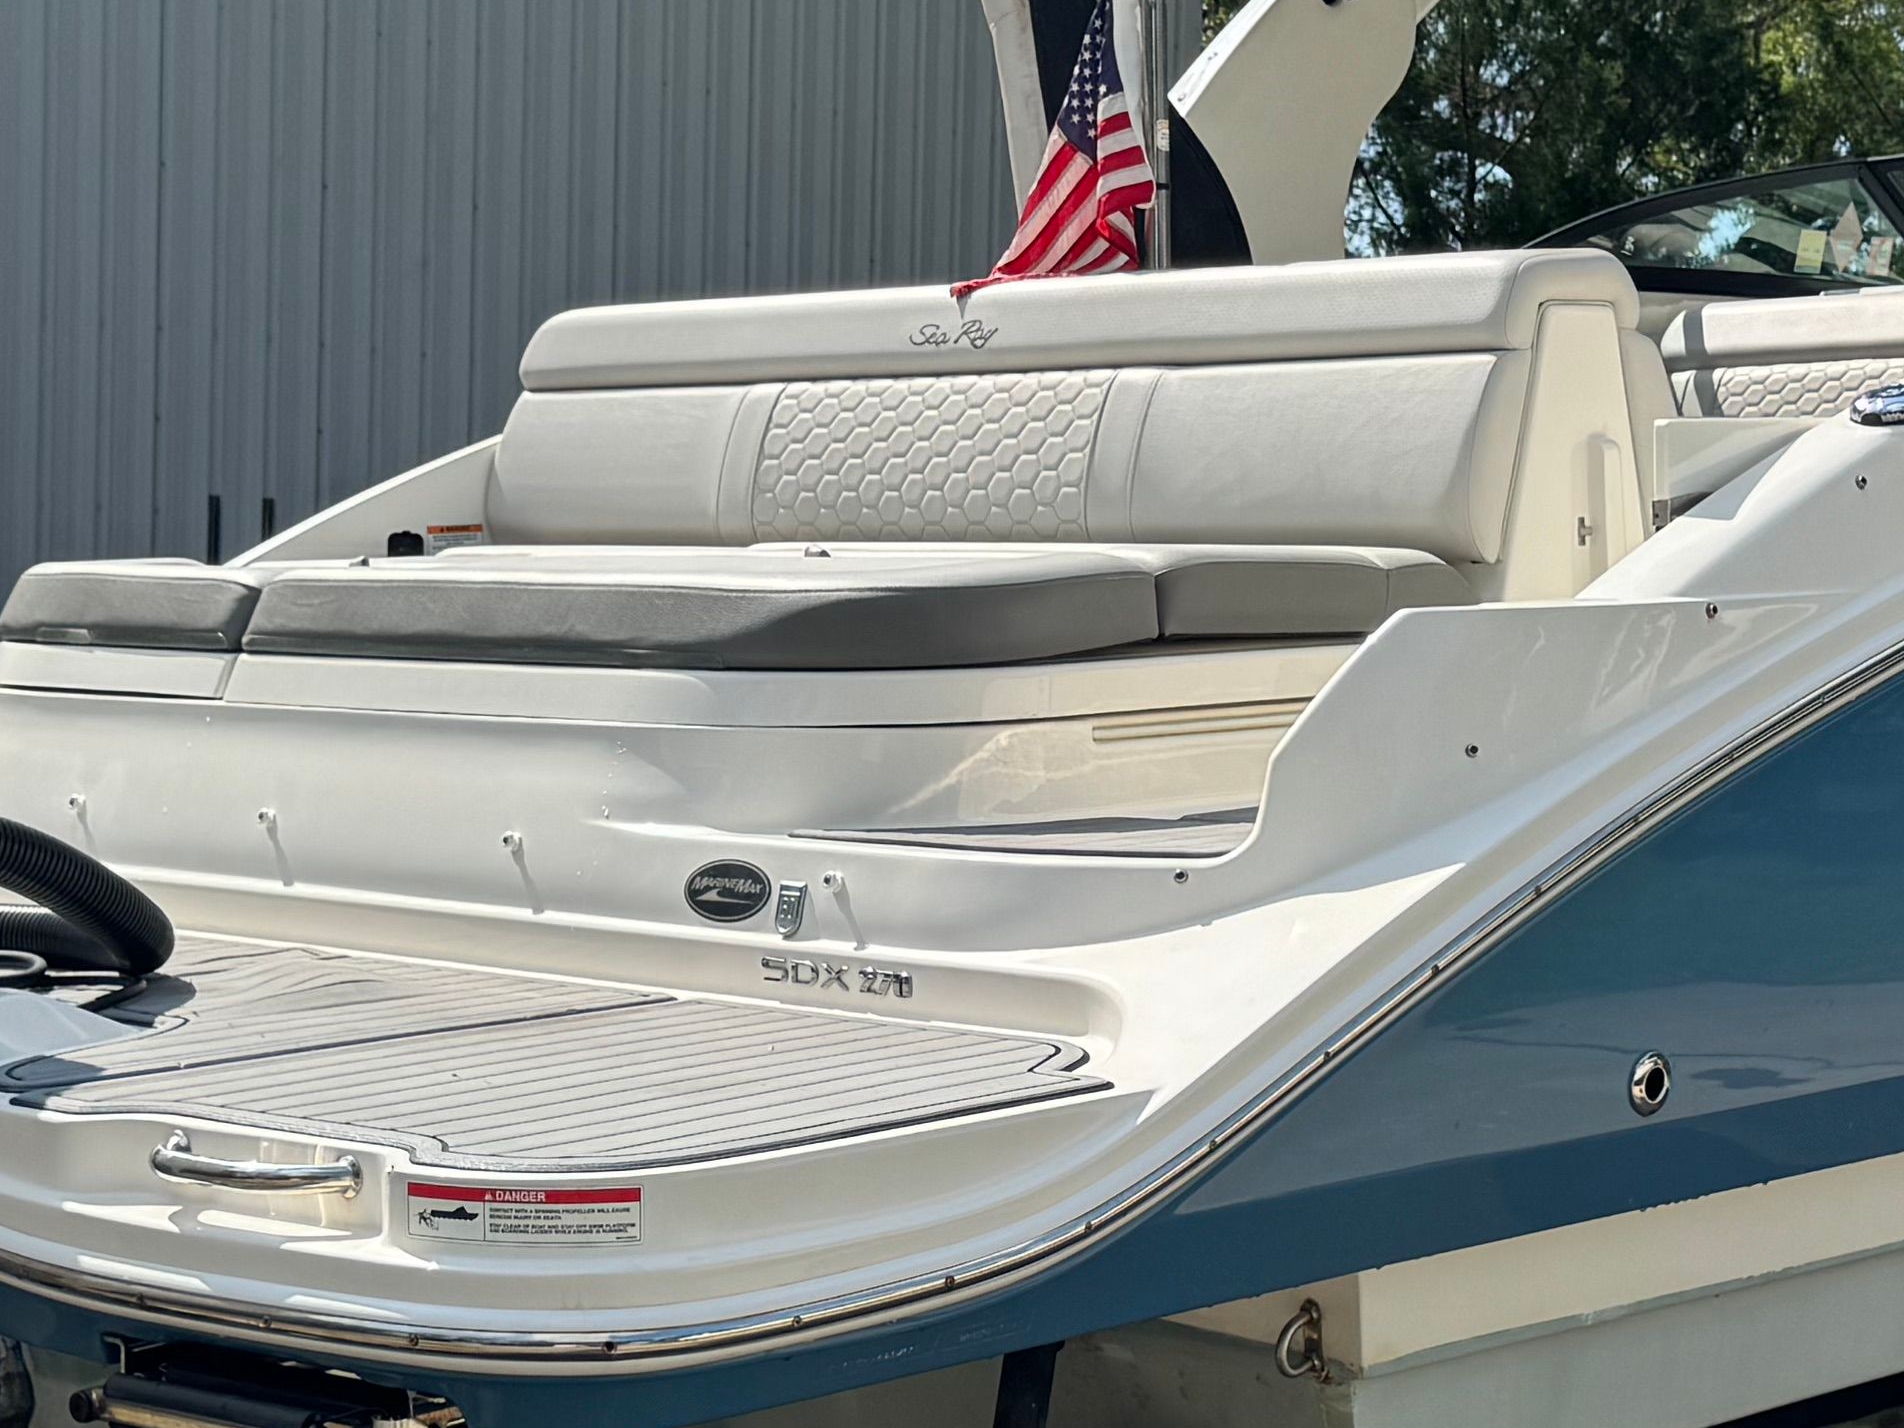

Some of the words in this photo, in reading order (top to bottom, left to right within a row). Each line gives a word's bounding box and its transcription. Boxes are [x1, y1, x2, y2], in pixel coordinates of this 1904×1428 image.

[909, 323, 951, 347] Sea
[953, 319, 999, 349] Ray
[761, 955, 850, 993] SDX
[496, 1190, 547, 1202] DANGER
